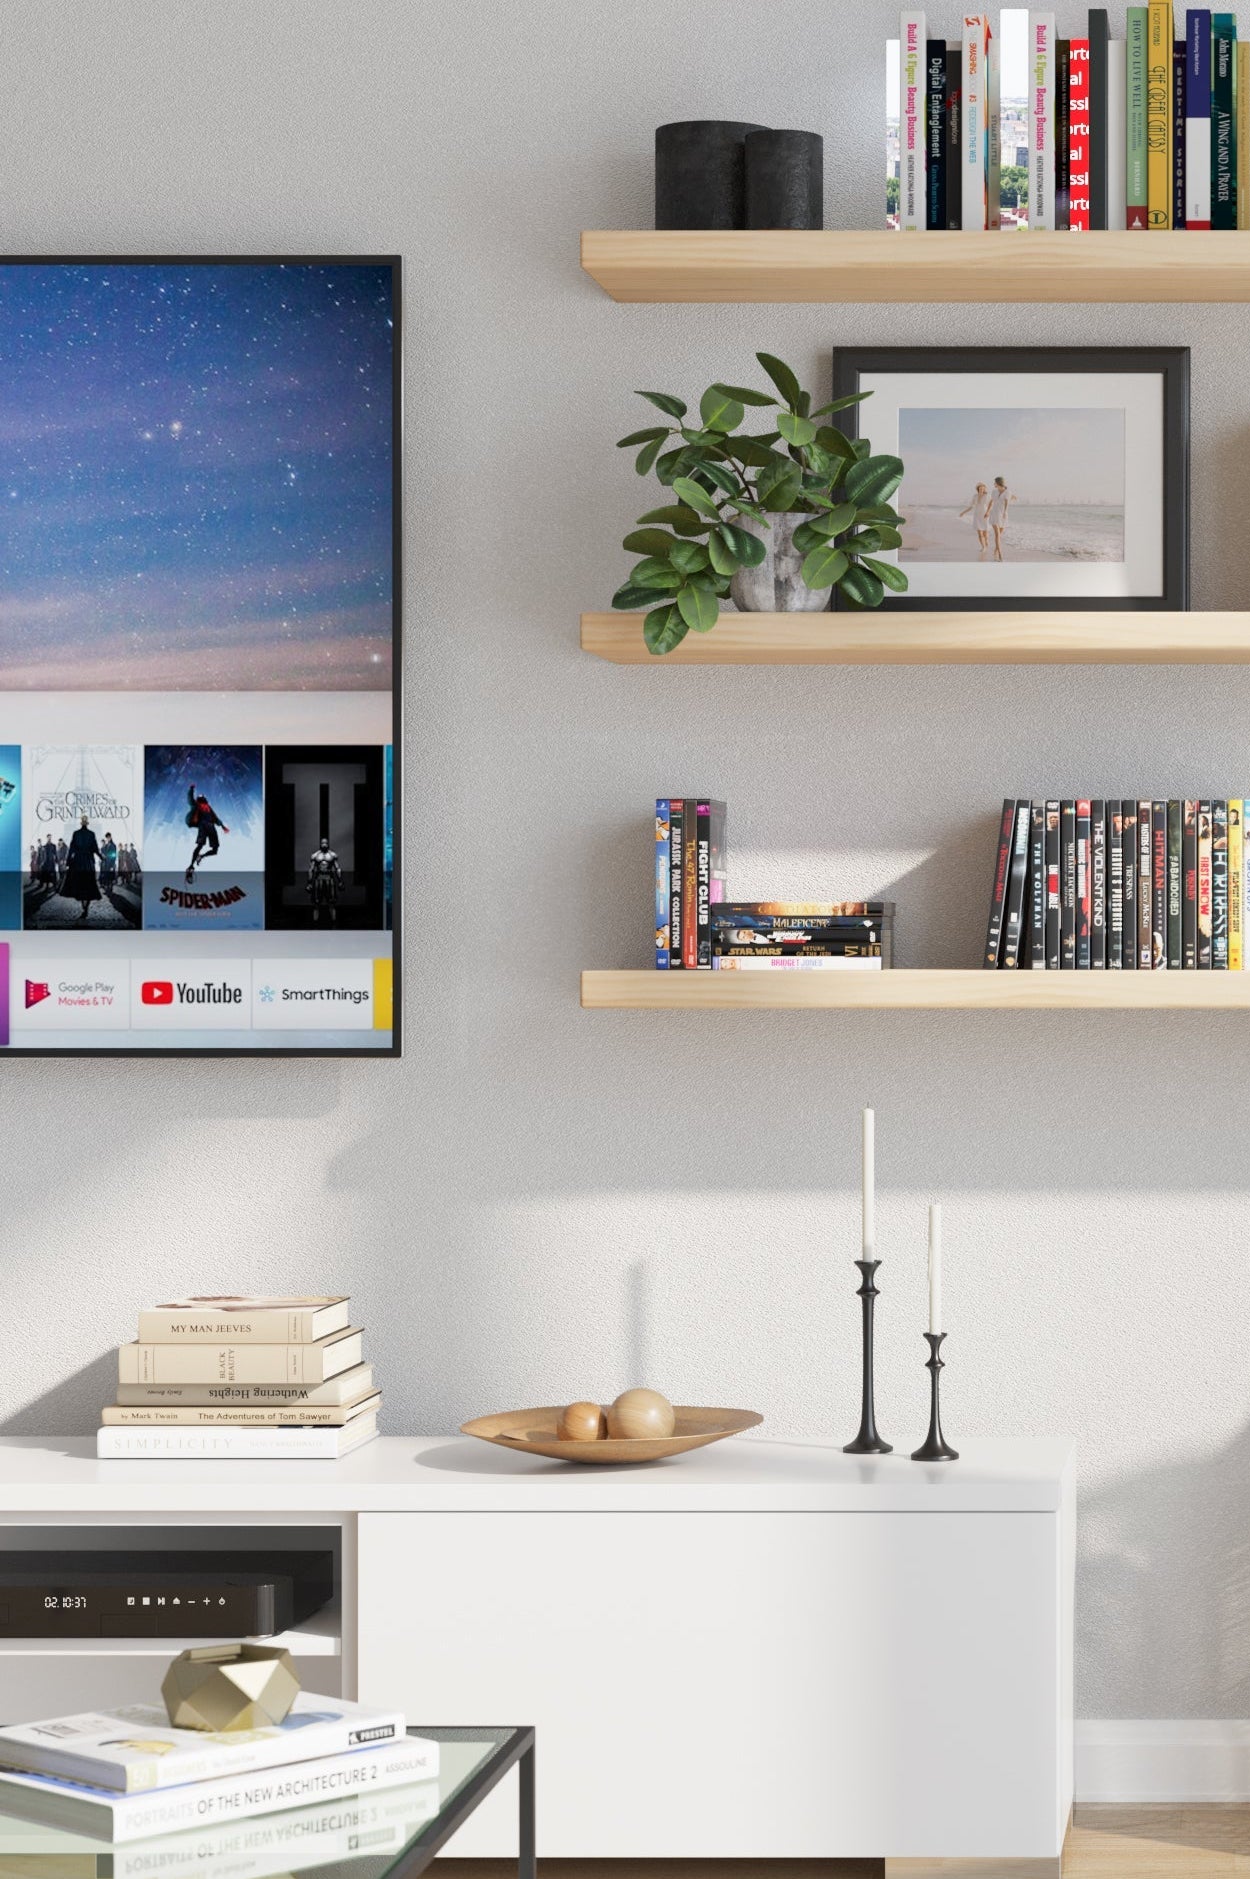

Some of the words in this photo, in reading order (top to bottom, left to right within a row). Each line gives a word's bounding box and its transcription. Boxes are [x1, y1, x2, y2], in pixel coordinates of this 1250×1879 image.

[907, 24, 917, 44] Build
[1036, 25, 1046, 44] Build
[1132, 20, 1142, 42] HOW
[1132, 44, 1142, 58] TO
[1218, 38, 1229, 54] John
[969, 43, 977, 75] SMASHING
[905, 61, 917, 85] Figure
[928, 58, 943, 88] Digital
[1034, 62, 1046, 86] Figure
[1132, 61, 1142, 82] LIVE
[1148, 66, 1166, 84] THE
[905, 87, 917, 114] Beauty
[1034, 88, 1046, 115] Beauty
[1132, 84, 1142, 108] WELL
[1148, 88, 1166, 116] GREAT
[907, 116, 917, 150] Business
[928, 94, 943, 158] Entanglement
[990, 115, 998, 142] STUART
[1036, 117, 1046, 150] Business
[1148, 120, 1166, 154] GATSBY
[1217, 120, 1230, 144] WING
[969, 136, 977, 148] THE
[969, 150, 977, 164] WEB
[990, 143, 998, 167] LITTLE
[1217, 146, 1230, 164] AND
[1217, 172, 1230, 202] PRAYER
[65, 792, 106, 806] CRIMES
[1016, 808, 1028, 854] INSOMNIA
[1094, 820, 1104, 844] THE
[672, 826, 682, 865] JURASSIC
[686, 840, 696, 860] The
[1034, 842, 1042, 865] THE
[686, 862, 696, 873] 47
[698, 840, 709, 884] FIGHT
[1155, 830, 1164, 889] HITMAN
[1200, 856, 1210, 877] FIRST
[672, 868, 682, 892] PARK
[1094, 846, 1104, 898] VIOLENT
[160, 885, 247, 910] SPIDER-MAN
[686, 876, 696, 903] Ronin
[1034, 872, 1042, 928] WOLFMAN
[1170, 862, 1178, 916] ABANDONED
[1200, 878, 1210, 915] SNOW
[698, 886, 709, 925] CLUB
[1094, 898, 1104, 926] KIND
[672, 896, 682, 948] COLLECTION
[728, 948, 756, 956] STAR
[756, 948, 782, 956] WARS
[771, 958, 799, 966] BRIDGET
[58, 981, 94, 995] Google
[96, 981, 115, 996] Play
[176, 982, 242, 1005] YouTube
[282, 988, 369, 1004] SmartThings
[58, 996, 90, 1007] Movies
[92, 996, 98, 1007] &
[101, 996, 114, 1007] TV
[170, 1324, 188, 1334] MY
[190, 1324, 213, 1334] MAN
[216, 1324, 252, 1334] JEEVES
[208, 1388, 250, 1400] Heights
[253, 1388, 309, 1400] Wuthering
[130, 1412, 152, 1420] Mark
[154, 1412, 178, 1420] Twain
[198, 1412, 212, 1420] The
[214, 1412, 265, 1420] Adventures
[267, 1412, 276, 1420] of
[278, 1412, 297, 1420] Tom
[299, 1412, 332, 1422] Sawyer
[114, 1438, 234, 1450] SIMPLICITY
[386, 1757, 427, 1773] ASSOULINE
[126, 1802, 193, 1830] PORTRAITS
[197, 1798, 214, 1814] OF
[218, 1793, 240, 1810] THE
[245, 1786, 274, 1804] NEW
[276, 1767, 368, 1799] ARCHITECTURE
[371, 1766, 377, 1779] 2
